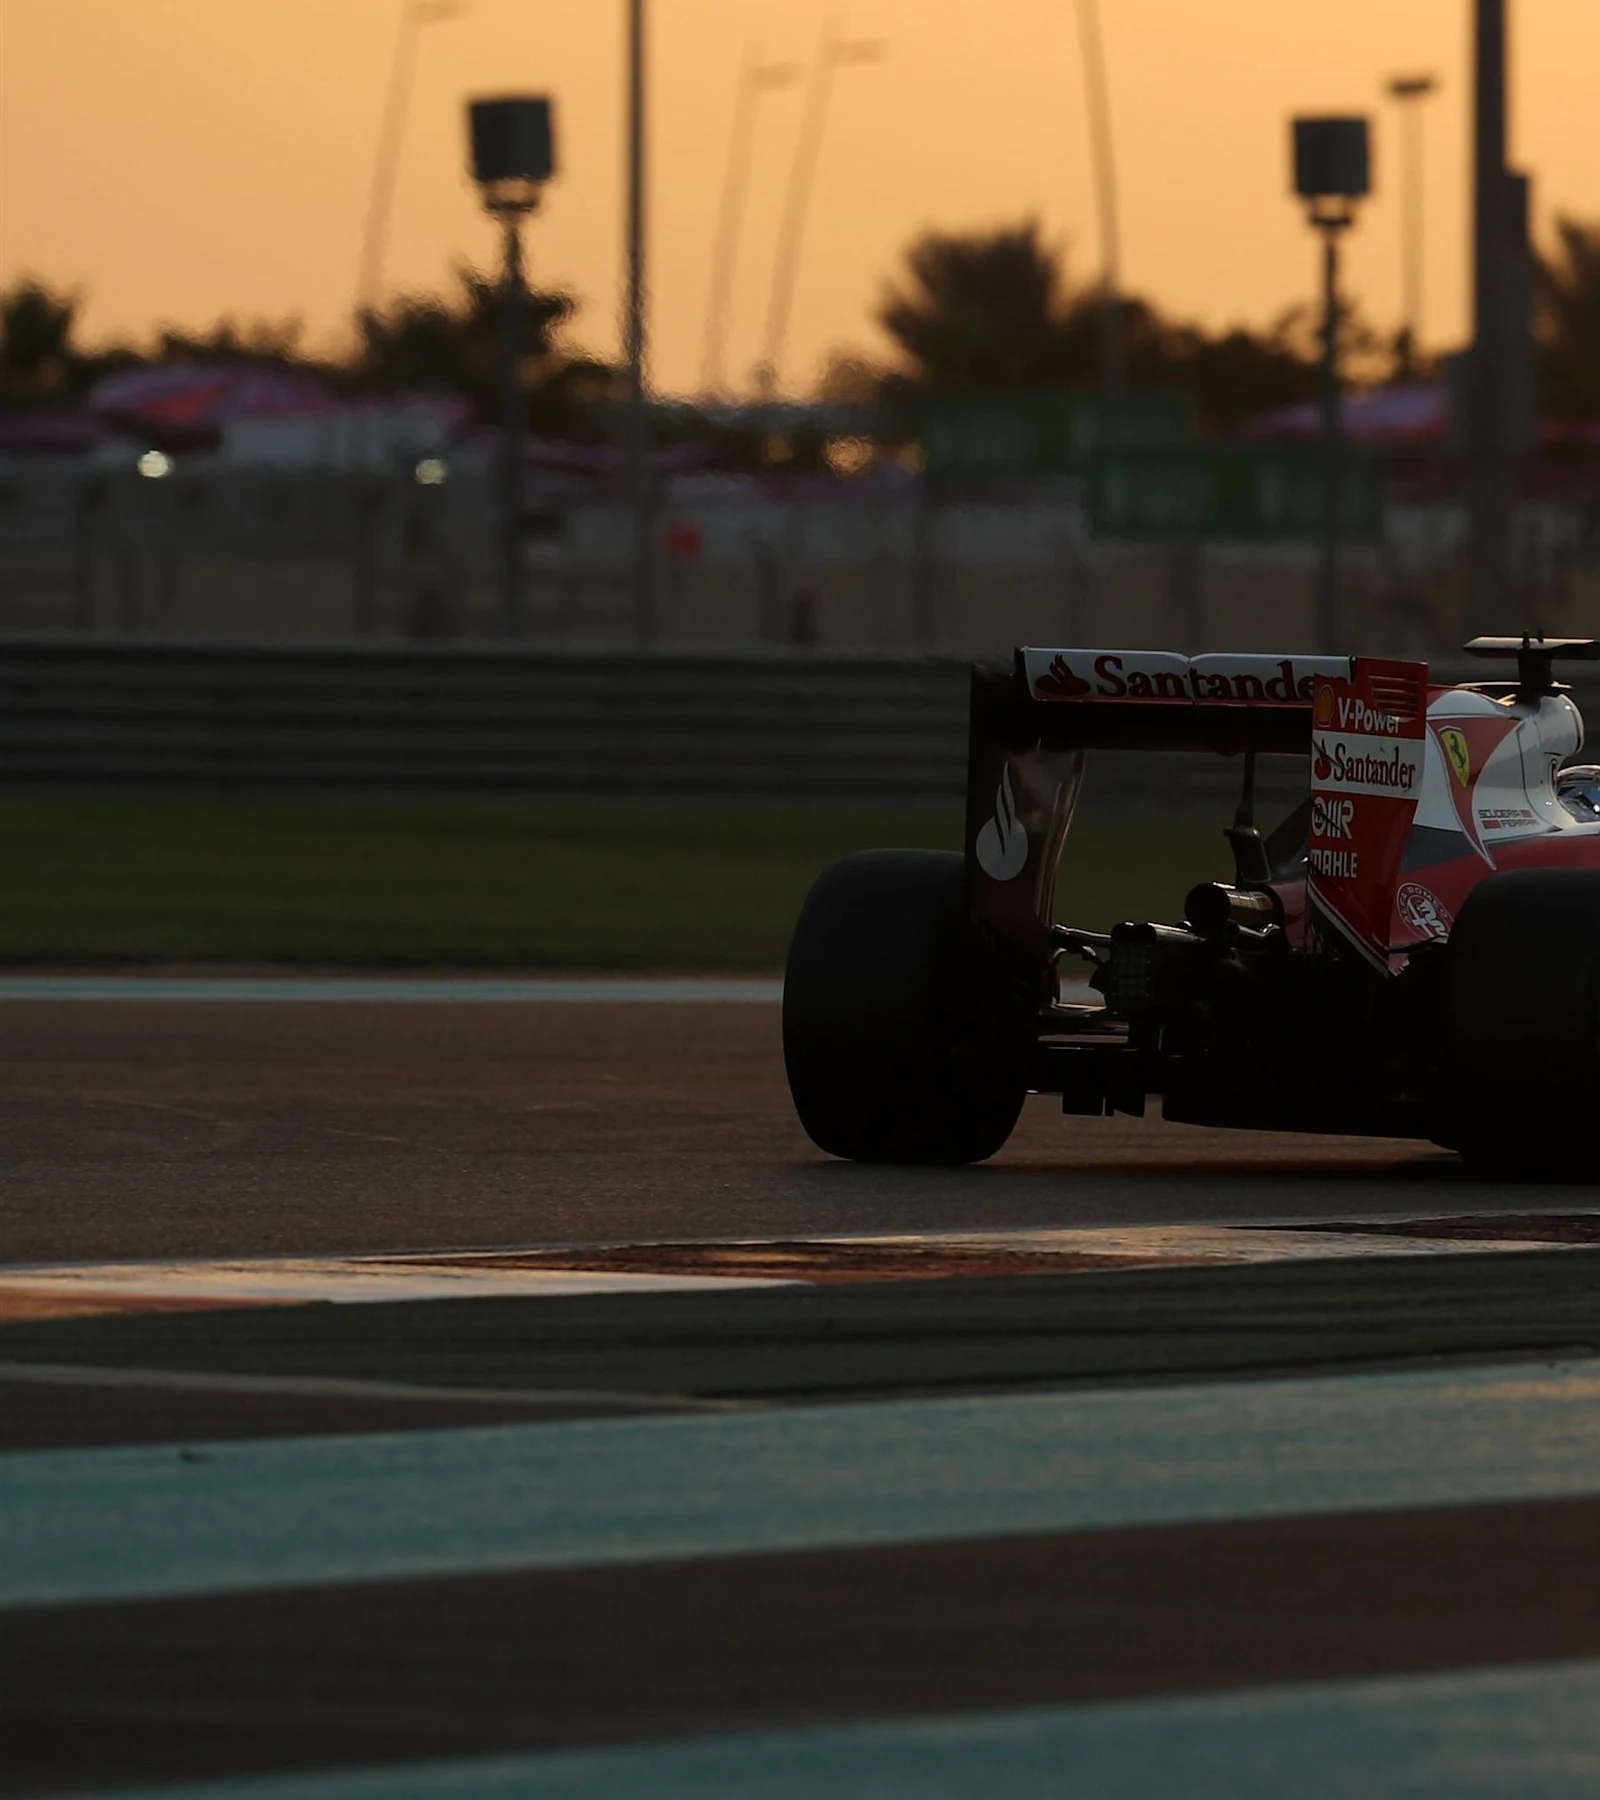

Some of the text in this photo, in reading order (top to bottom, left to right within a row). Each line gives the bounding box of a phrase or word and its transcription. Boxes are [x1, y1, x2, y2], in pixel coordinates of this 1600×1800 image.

[1093, 655, 1348, 701] Santande
[1338, 697, 1400, 734] V-Power
[1334, 742, 1416, 790] Santander
[1309, 849, 1358, 879] MAHLE
